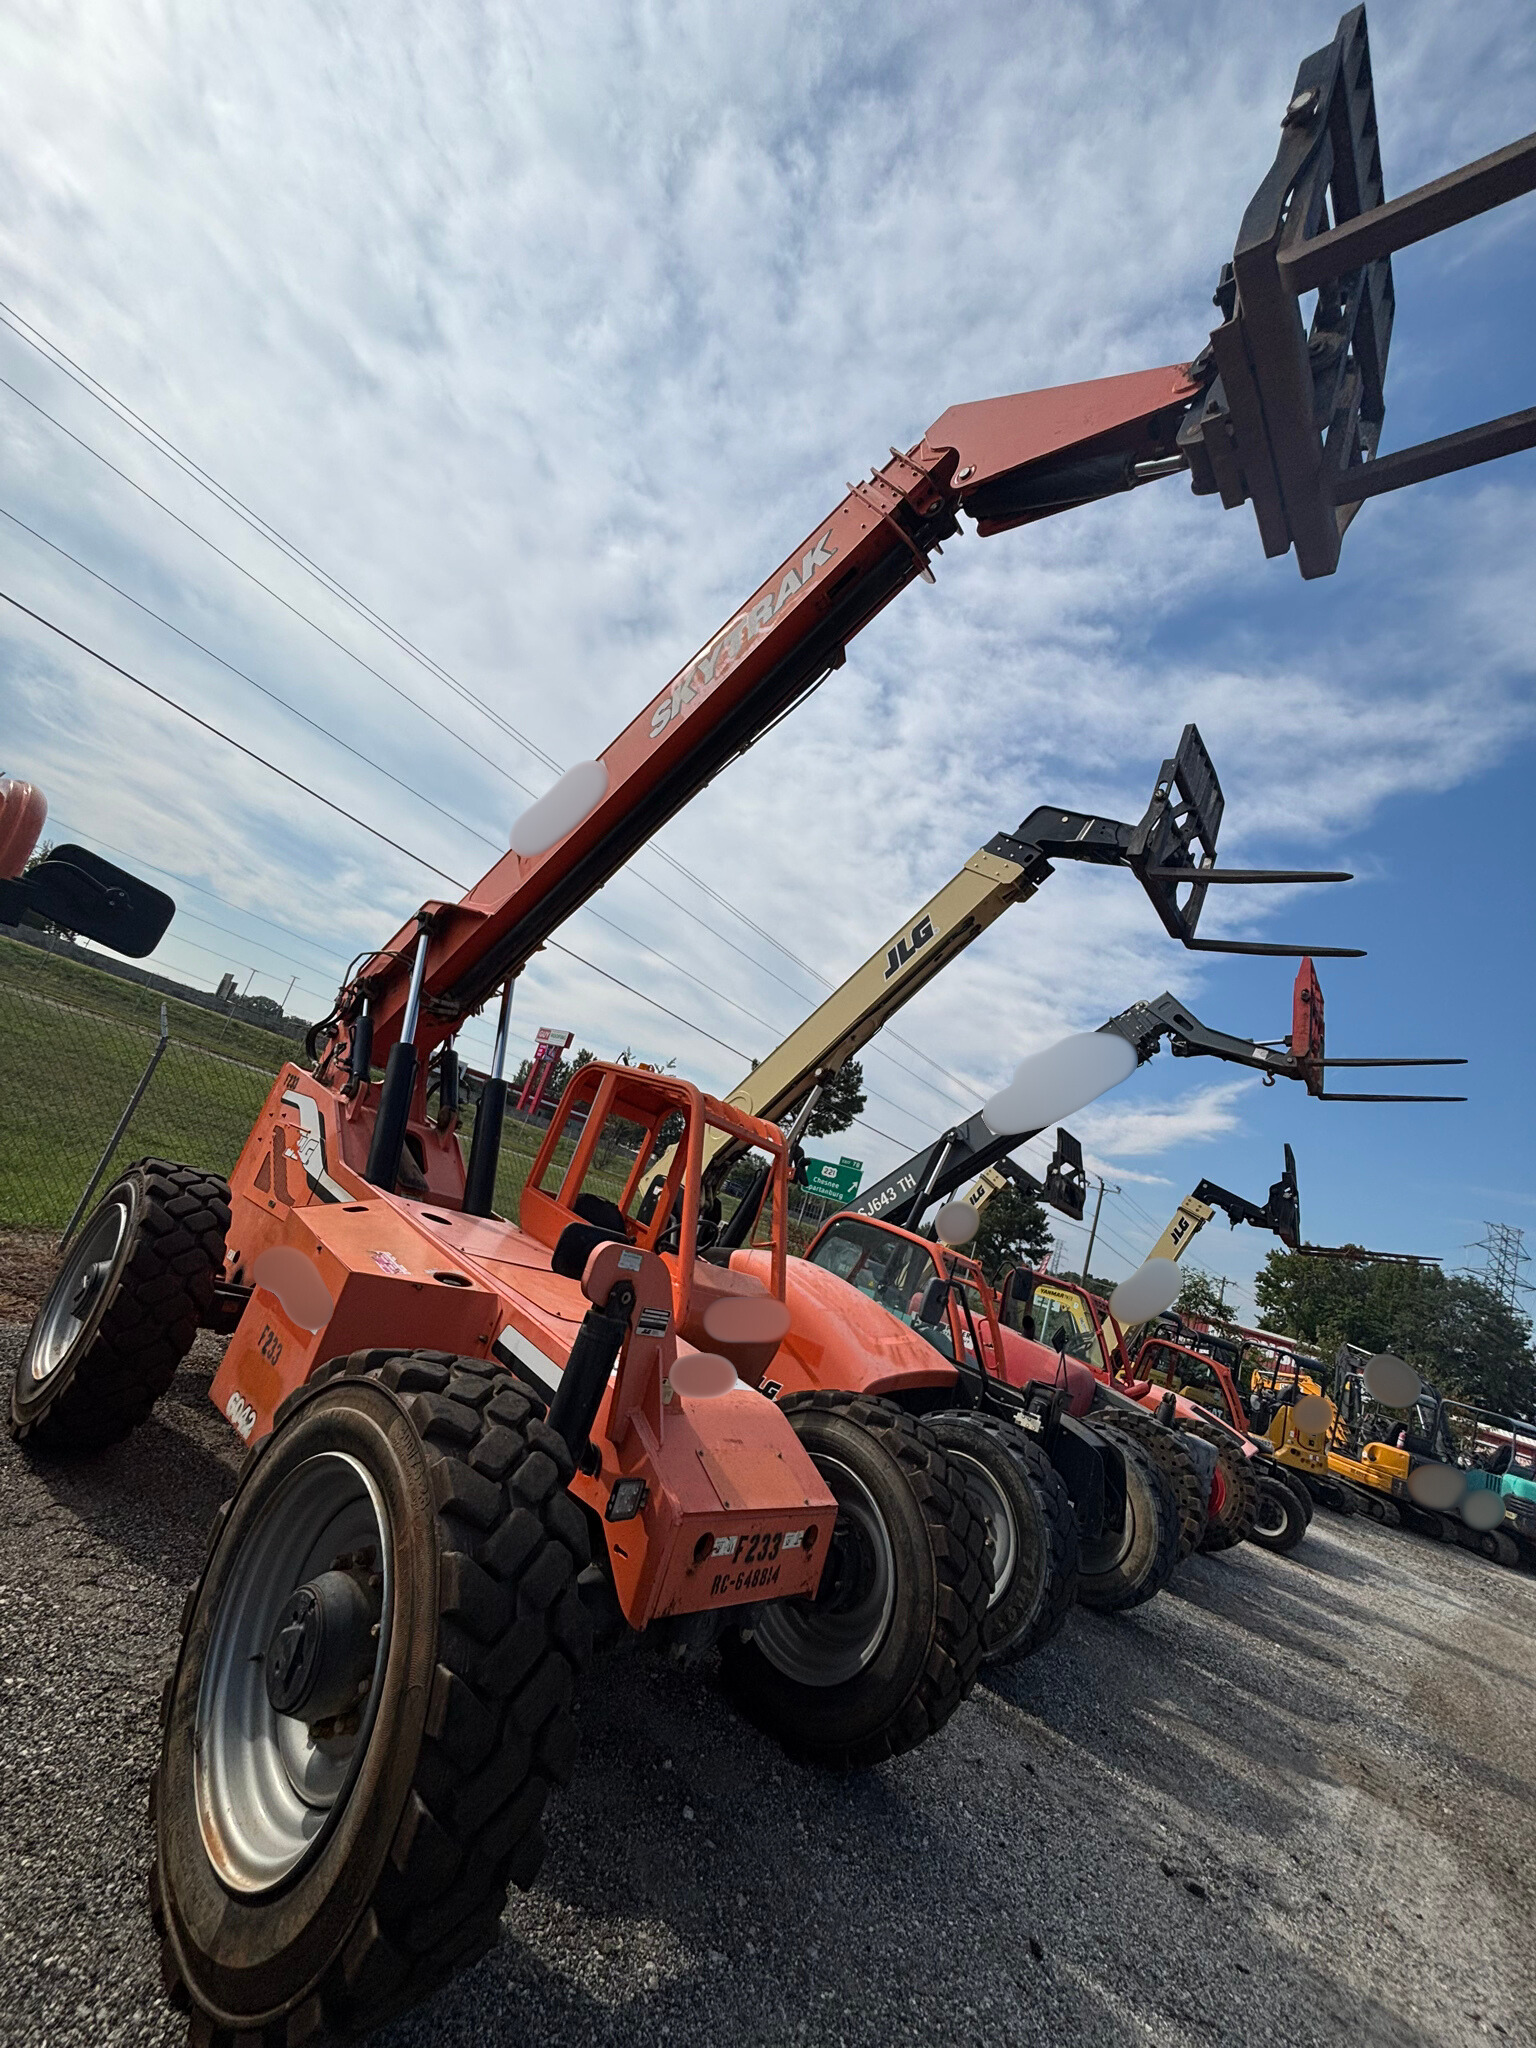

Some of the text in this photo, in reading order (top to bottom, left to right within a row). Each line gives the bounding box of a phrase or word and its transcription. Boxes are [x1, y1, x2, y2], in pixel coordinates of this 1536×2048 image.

[883, 913, 935, 981] JLG
[813, 1176, 840, 1189] Chesnee
[823, 1167, 836, 1176] 221
[896, 1173, 917, 1193] TH
[1170, 1216, 1190, 1246] JLG
[1040, 1288, 1065, 1298] YANMAR
[257, 1323, 283, 1366] F233
[732, 1532, 782, 1564] F233
